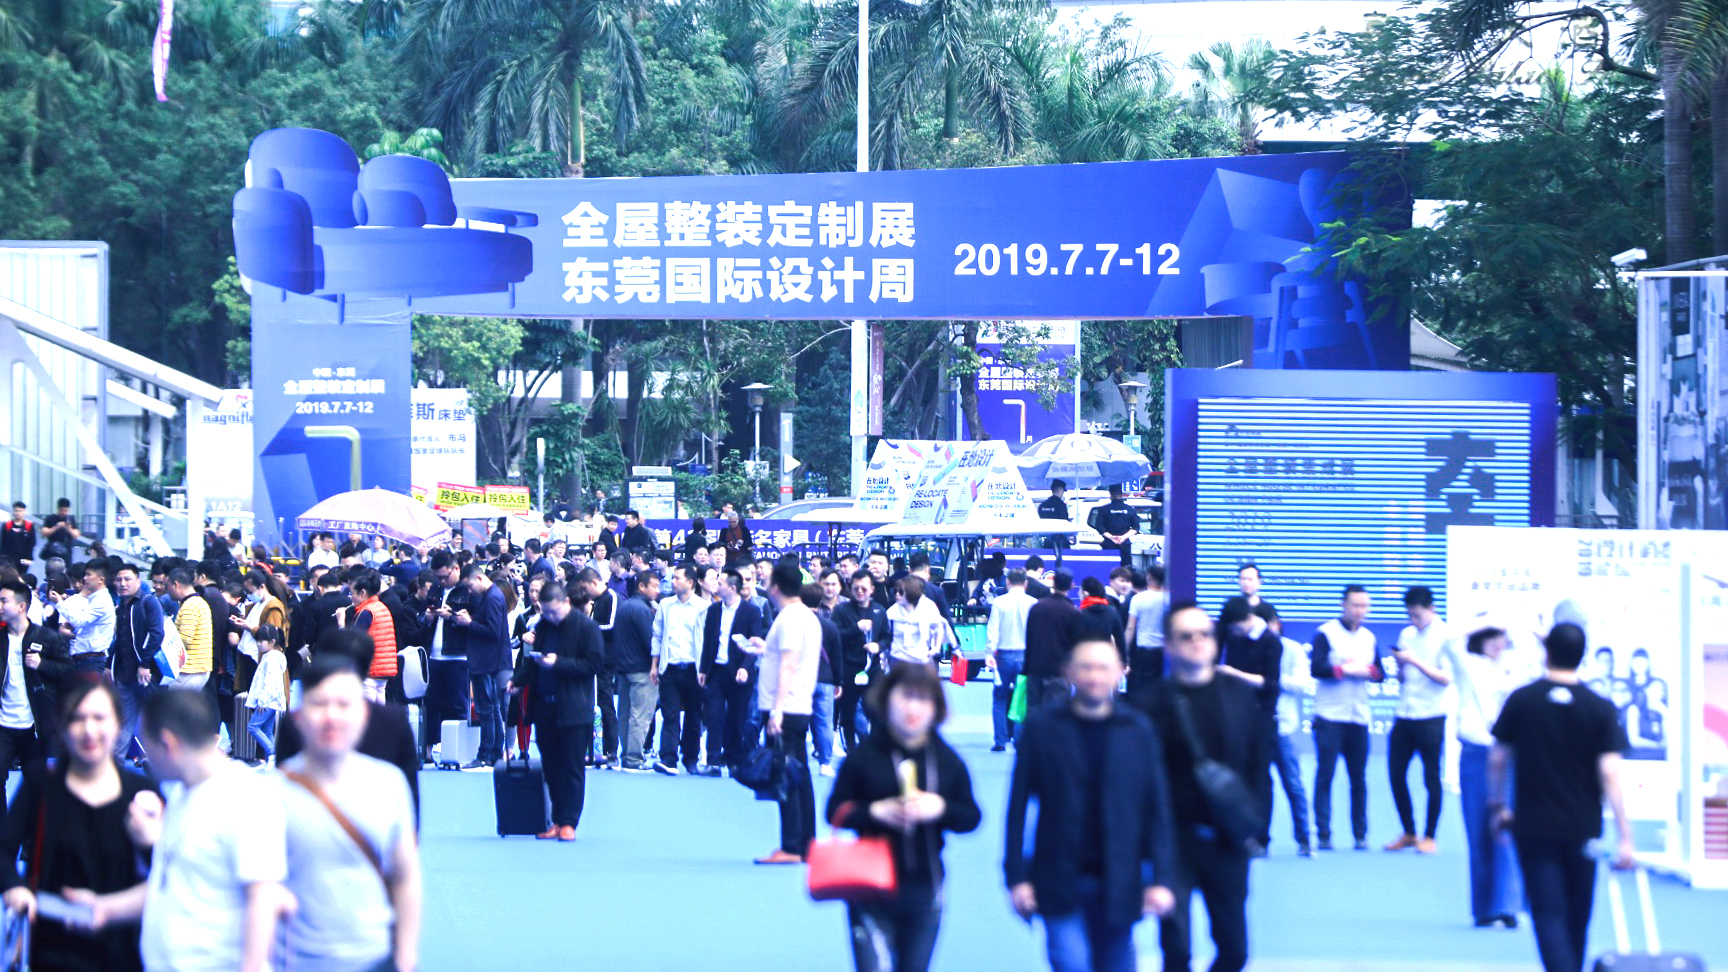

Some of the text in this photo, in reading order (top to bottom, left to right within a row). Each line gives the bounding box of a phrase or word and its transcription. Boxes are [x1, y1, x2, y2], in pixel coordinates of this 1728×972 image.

[562, 201, 916, 248] 全屋整装定制展
[954, 242, 1181, 276] 2019.7.7-12
[562, 256, 914, 304] 东莞国际设计周
[295, 401, 374, 414] 2019.7.7-12
